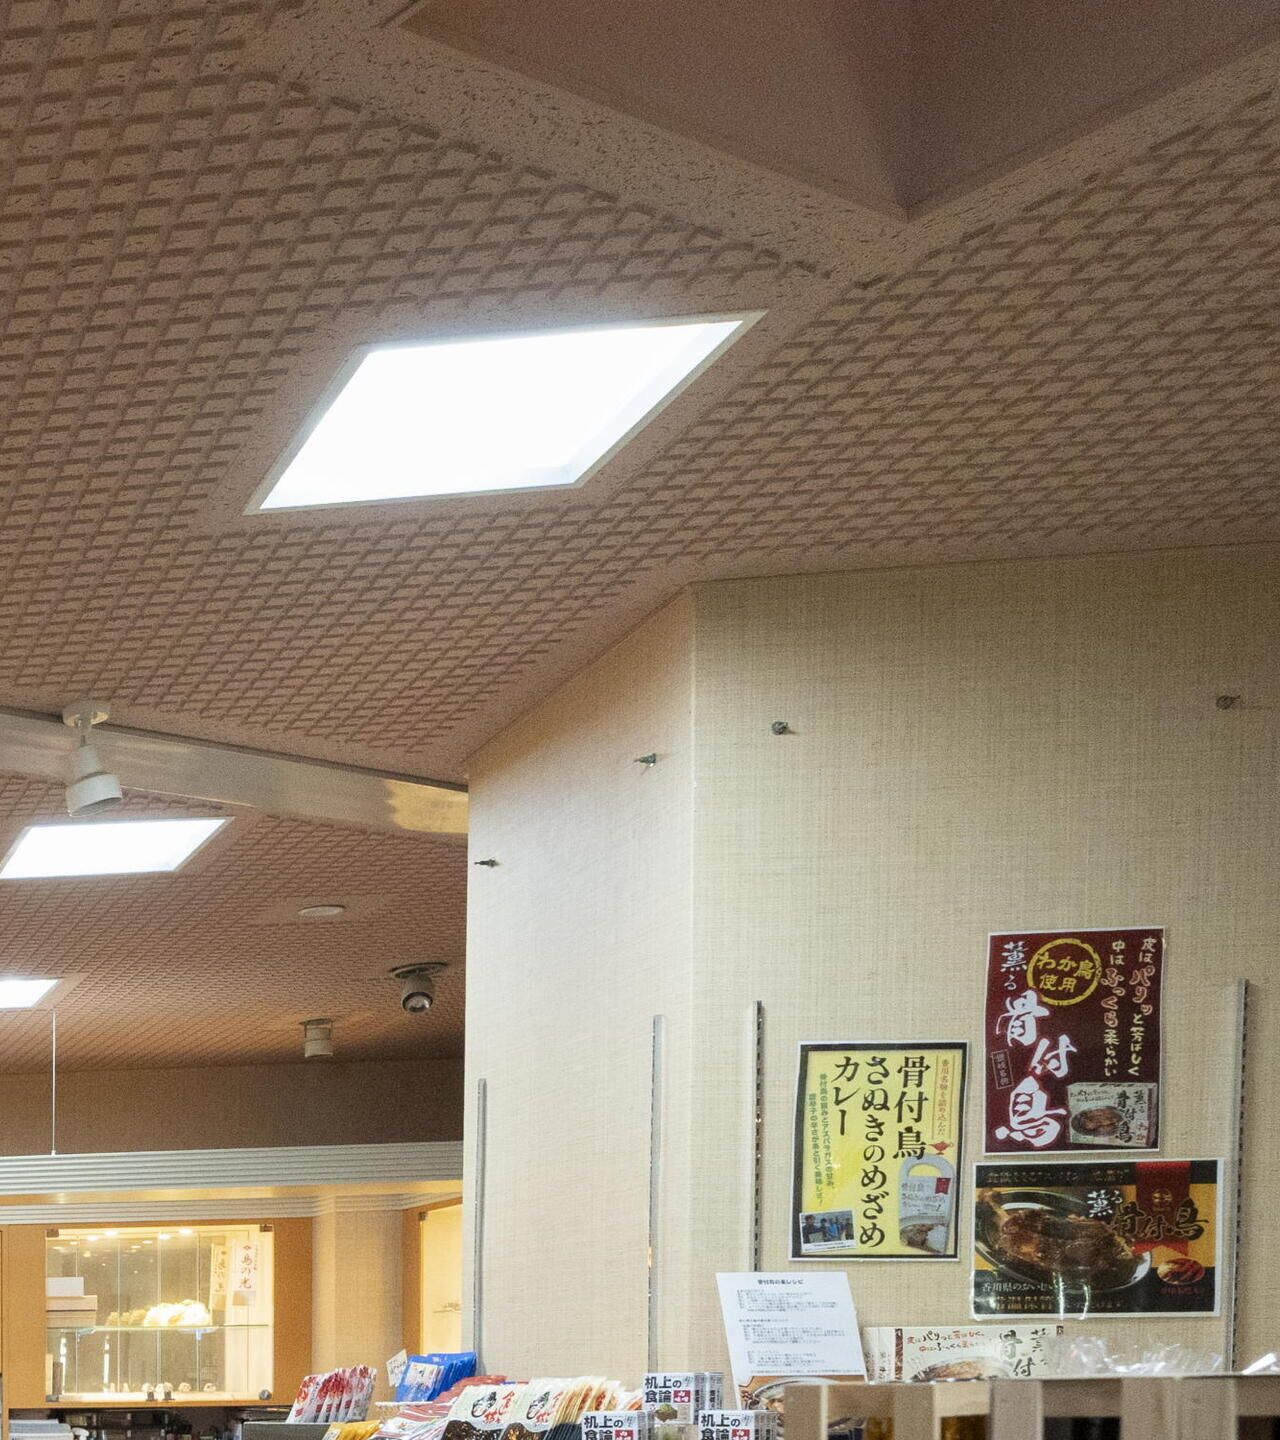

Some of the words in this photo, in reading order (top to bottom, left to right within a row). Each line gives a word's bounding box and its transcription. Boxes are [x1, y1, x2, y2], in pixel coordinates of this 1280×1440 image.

[1040, 974, 1077, 993] 使用
[995, 989, 1077, 1147] 骨付鳥
[831, 1056, 860, 1135] カレー
[892, 1056, 930, 1160] 骨付鳥
[860, 1056, 890, 1247] さぬきのめざめ
[645, 1375, 682, 1390] 机上の
[645, 1390, 673, 1403] 食論
[584, 1414, 623, 1429] 机上の
[701, 1413, 741, 1428] 机上の
